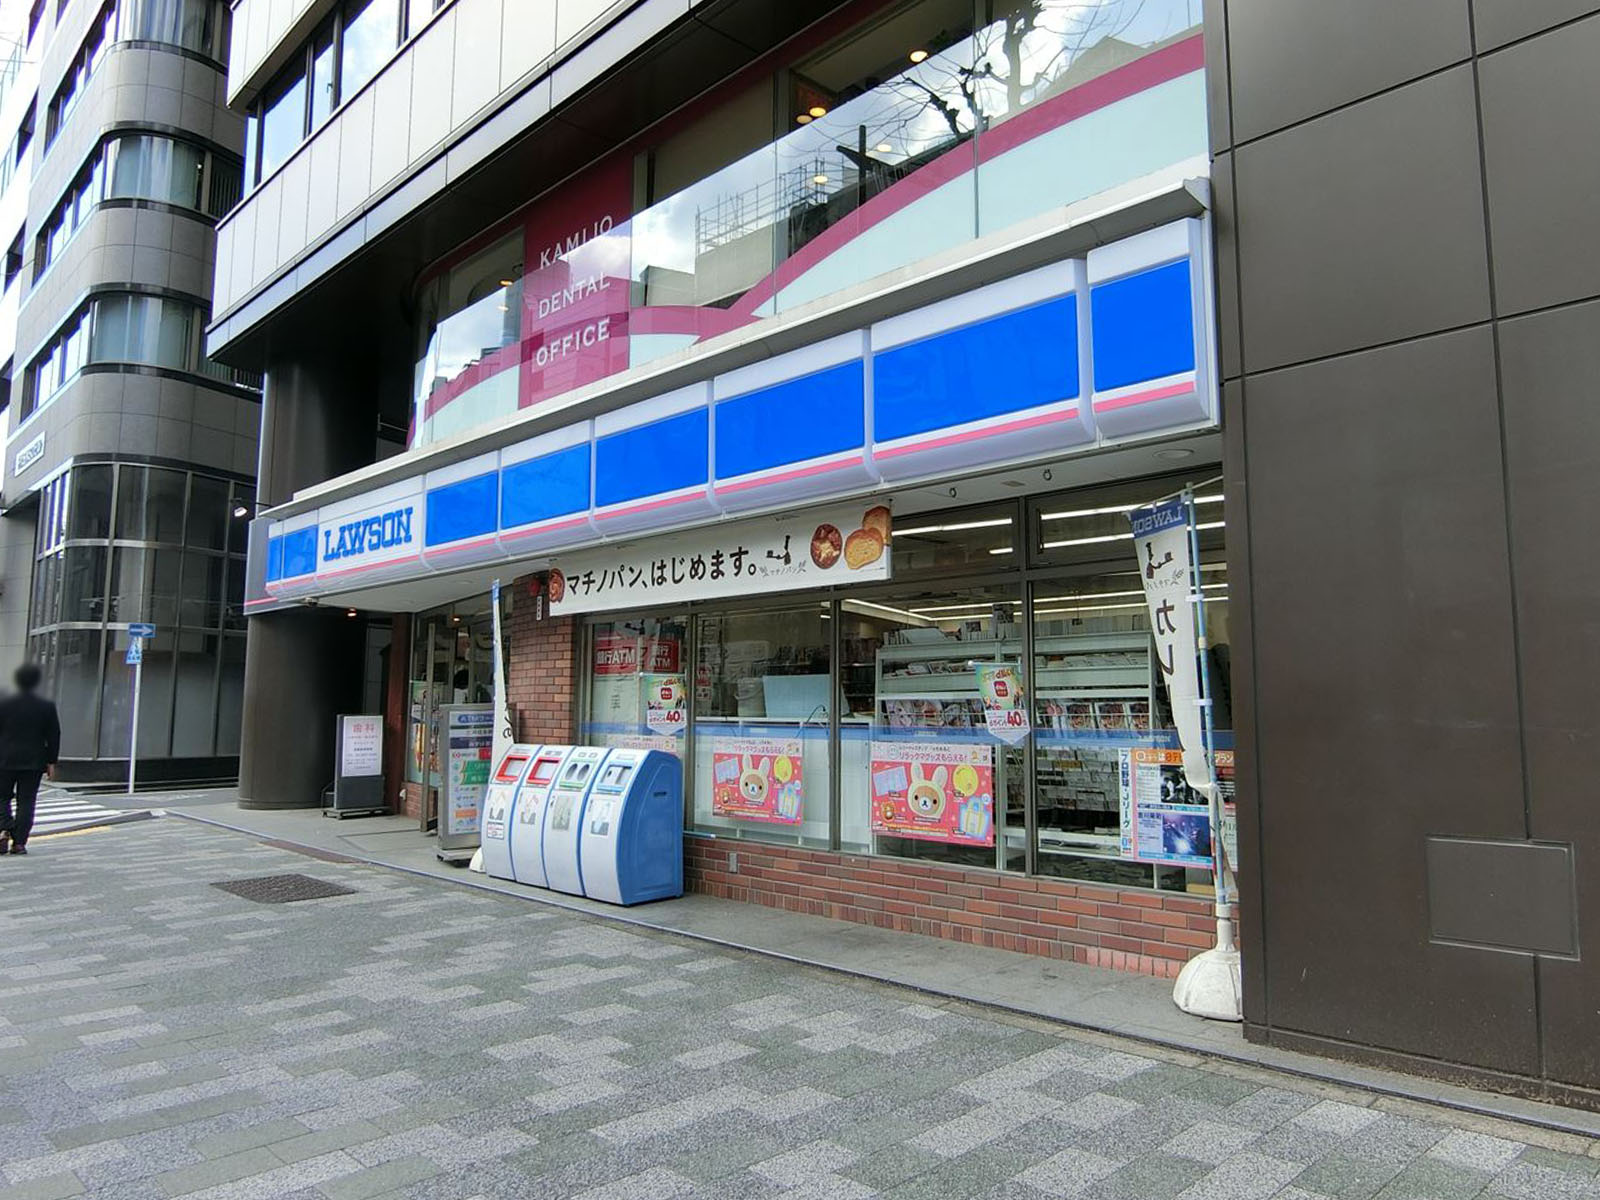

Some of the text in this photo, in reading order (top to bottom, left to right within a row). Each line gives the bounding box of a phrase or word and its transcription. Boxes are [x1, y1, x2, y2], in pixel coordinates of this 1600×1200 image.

[538, 271, 611, 319] DENTAL
[536, 315, 611, 366] OFFICE
[322, 505, 414, 562] LAWSON
[566, 545, 757, 596] マチノパン、はじめます。
[649, 657, 671, 668] ATM
[666, 710, 681, 722] 40
[1007, 711, 1022, 726] 40
